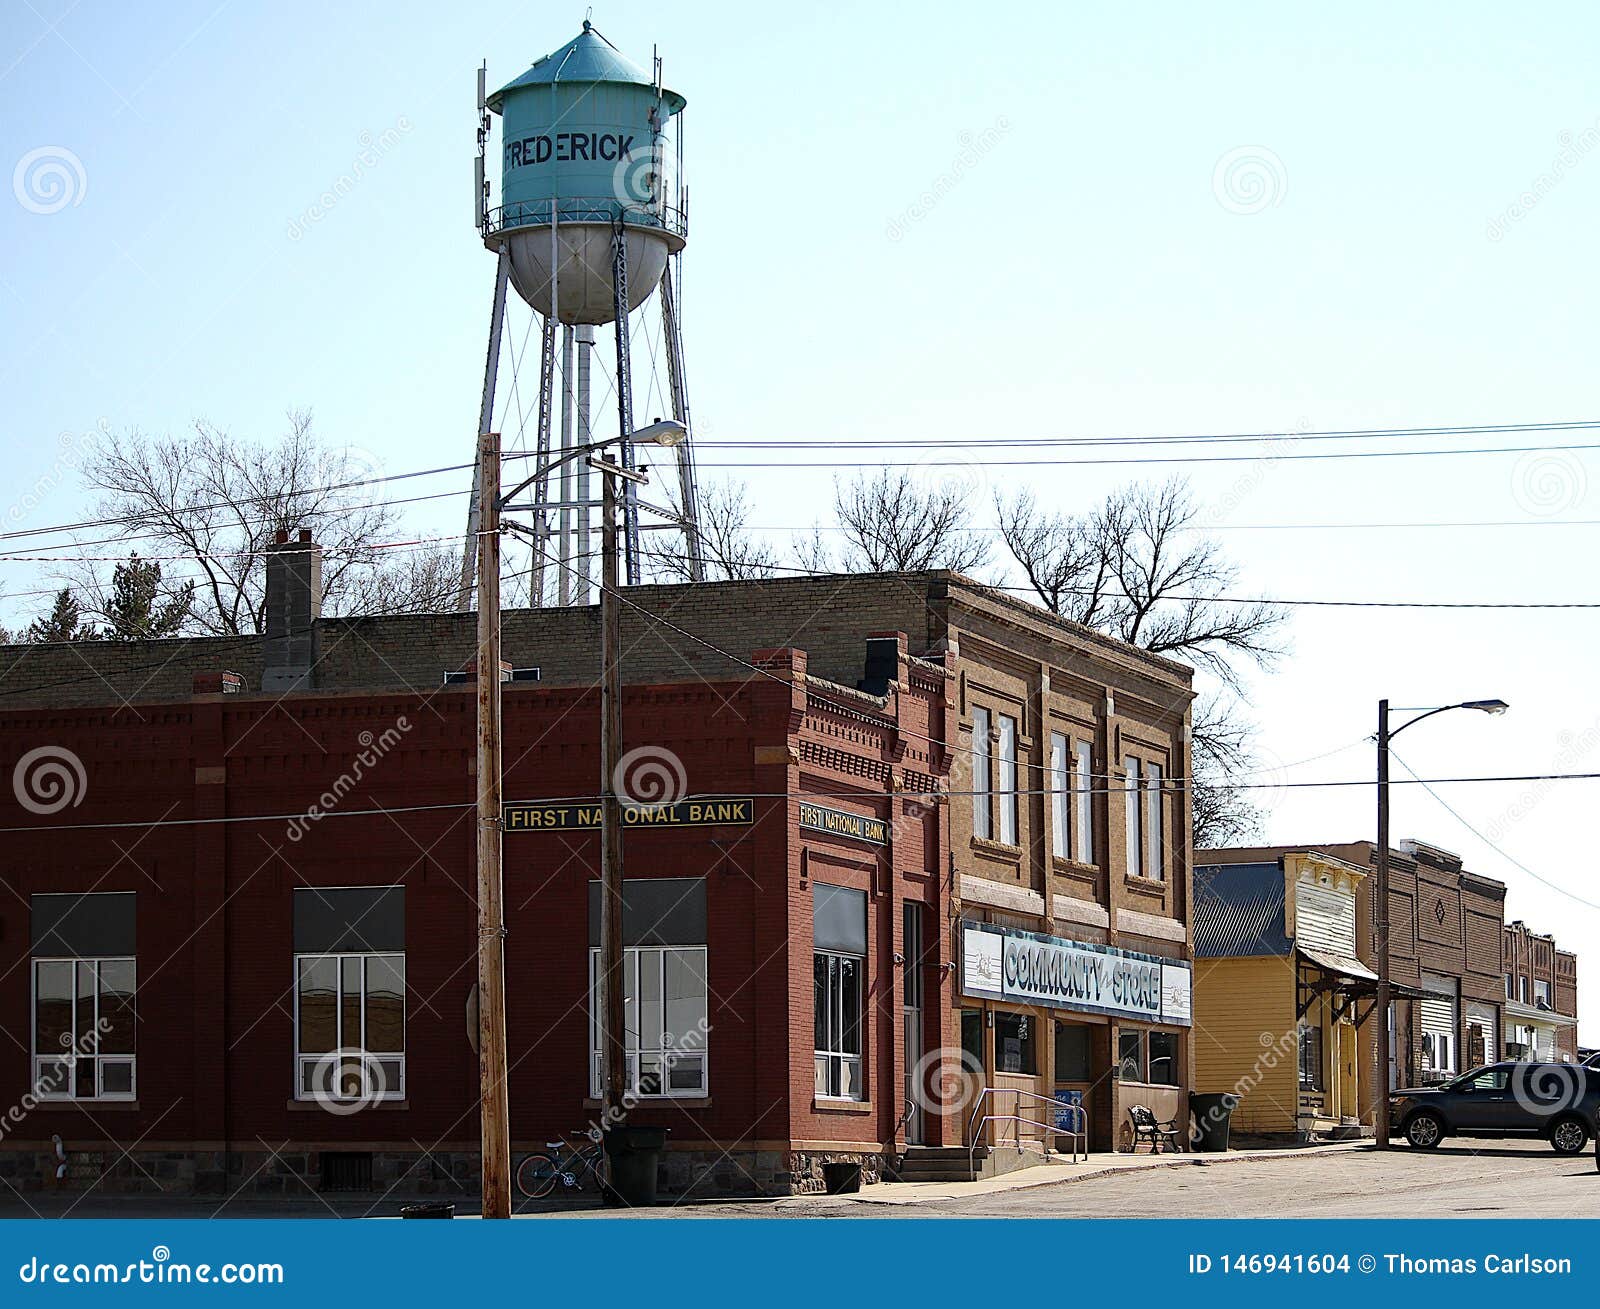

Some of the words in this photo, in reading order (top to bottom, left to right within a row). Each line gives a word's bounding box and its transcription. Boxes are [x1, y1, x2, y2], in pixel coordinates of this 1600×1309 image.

[511, 810, 568, 827] FIRST
[577, 805, 680, 825] NAONAL
[690, 803, 746, 821] BANK
[800, 806, 821, 826] FIRST
[825, 812, 861, 835] NATIONAL
[865, 822, 884, 841] BANK
[1005, 943, 1104, 1001] COMMUNITY
[1112, 961, 1160, 1010] STORE
